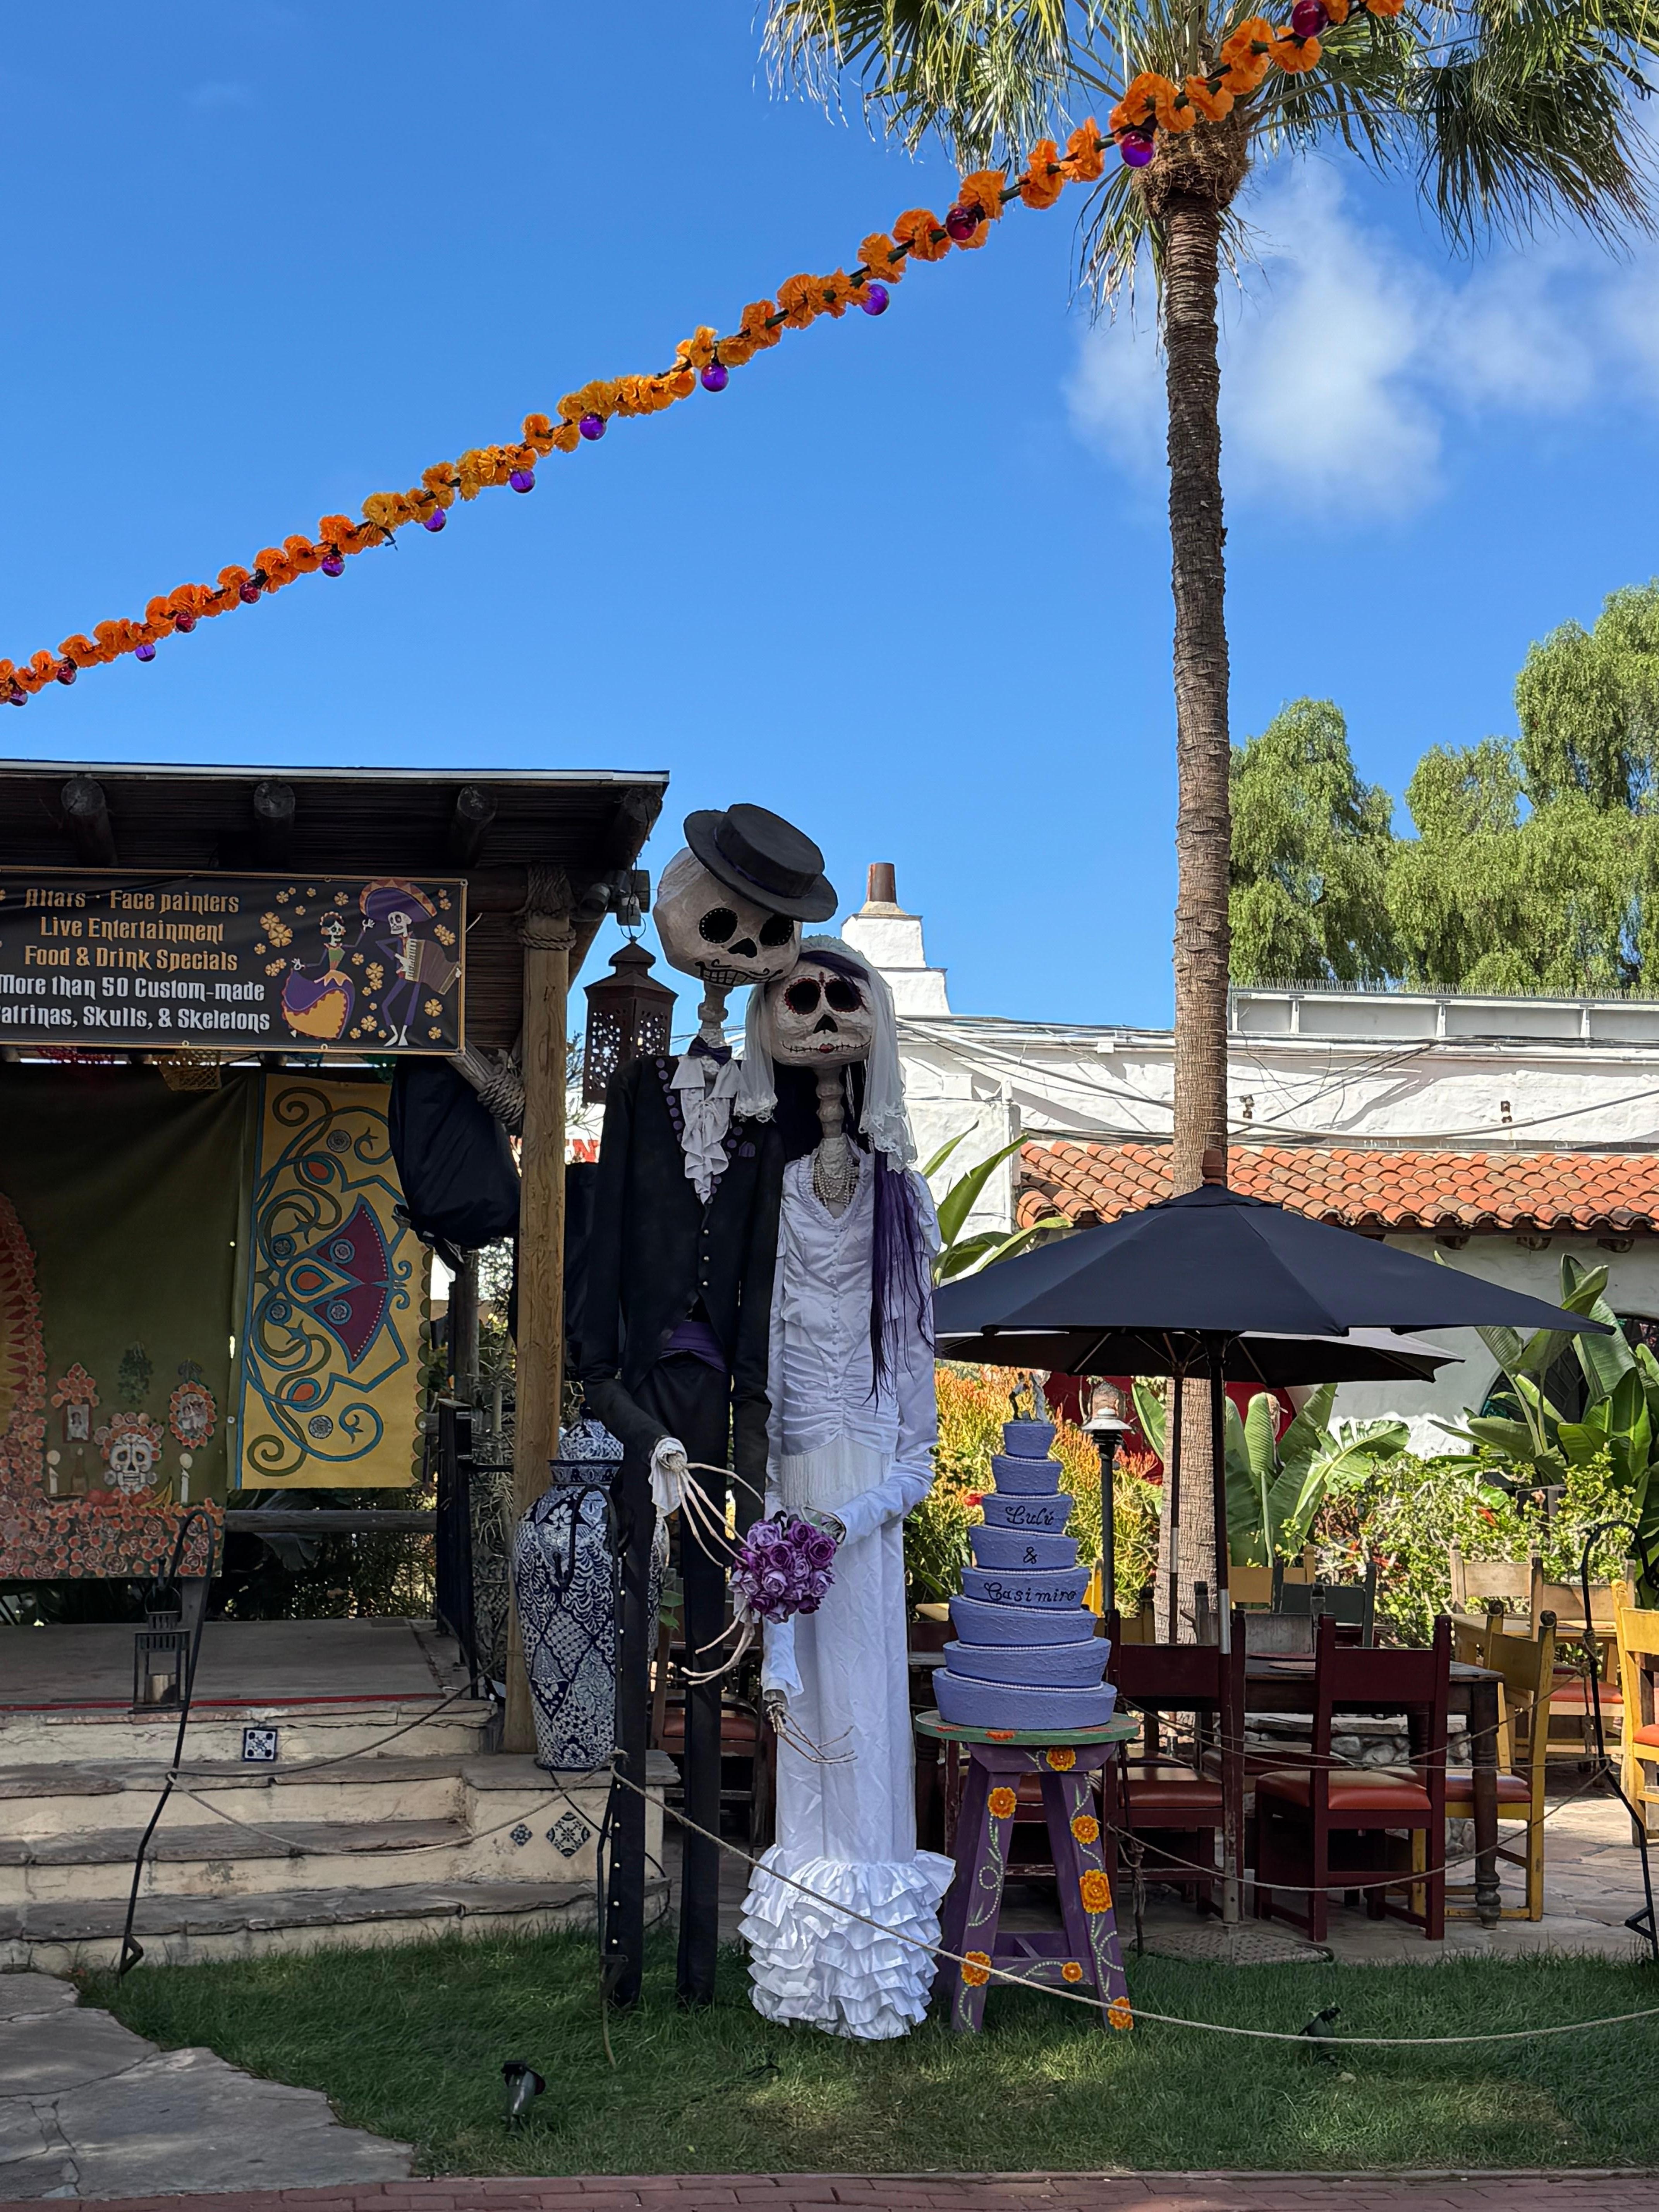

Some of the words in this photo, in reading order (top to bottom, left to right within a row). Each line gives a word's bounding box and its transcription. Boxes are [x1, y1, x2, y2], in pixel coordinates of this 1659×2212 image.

[25, 888, 86, 908] Altars
[110, 890, 155, 910] Face
[159, 891, 239, 915] painters
[41, 917, 82, 936] Live
[88, 917, 224, 945] Entertainment
[25, 945, 70, 966] Food
[76, 947, 90, 966] &
[96, 947, 152, 972] Drink
[156, 949, 238, 973] Specials
[0, 974, 46, 995] More
[52, 975, 96, 1000] than
[102, 977, 129, 997] 50
[135, 977, 265, 1002] Custom-made
[0, 1004, 78, 1029] atrinas,
[83, 1005, 153, 1030] Skulls,
[158, 1008, 172, 1028] &
[178, 1008, 270, 1034] Skeletons
[1005, 1505, 1054, 1525] Lulú
[1023, 1546, 1038, 1564] &
[984, 1582, 1077, 1602] Casimiro
